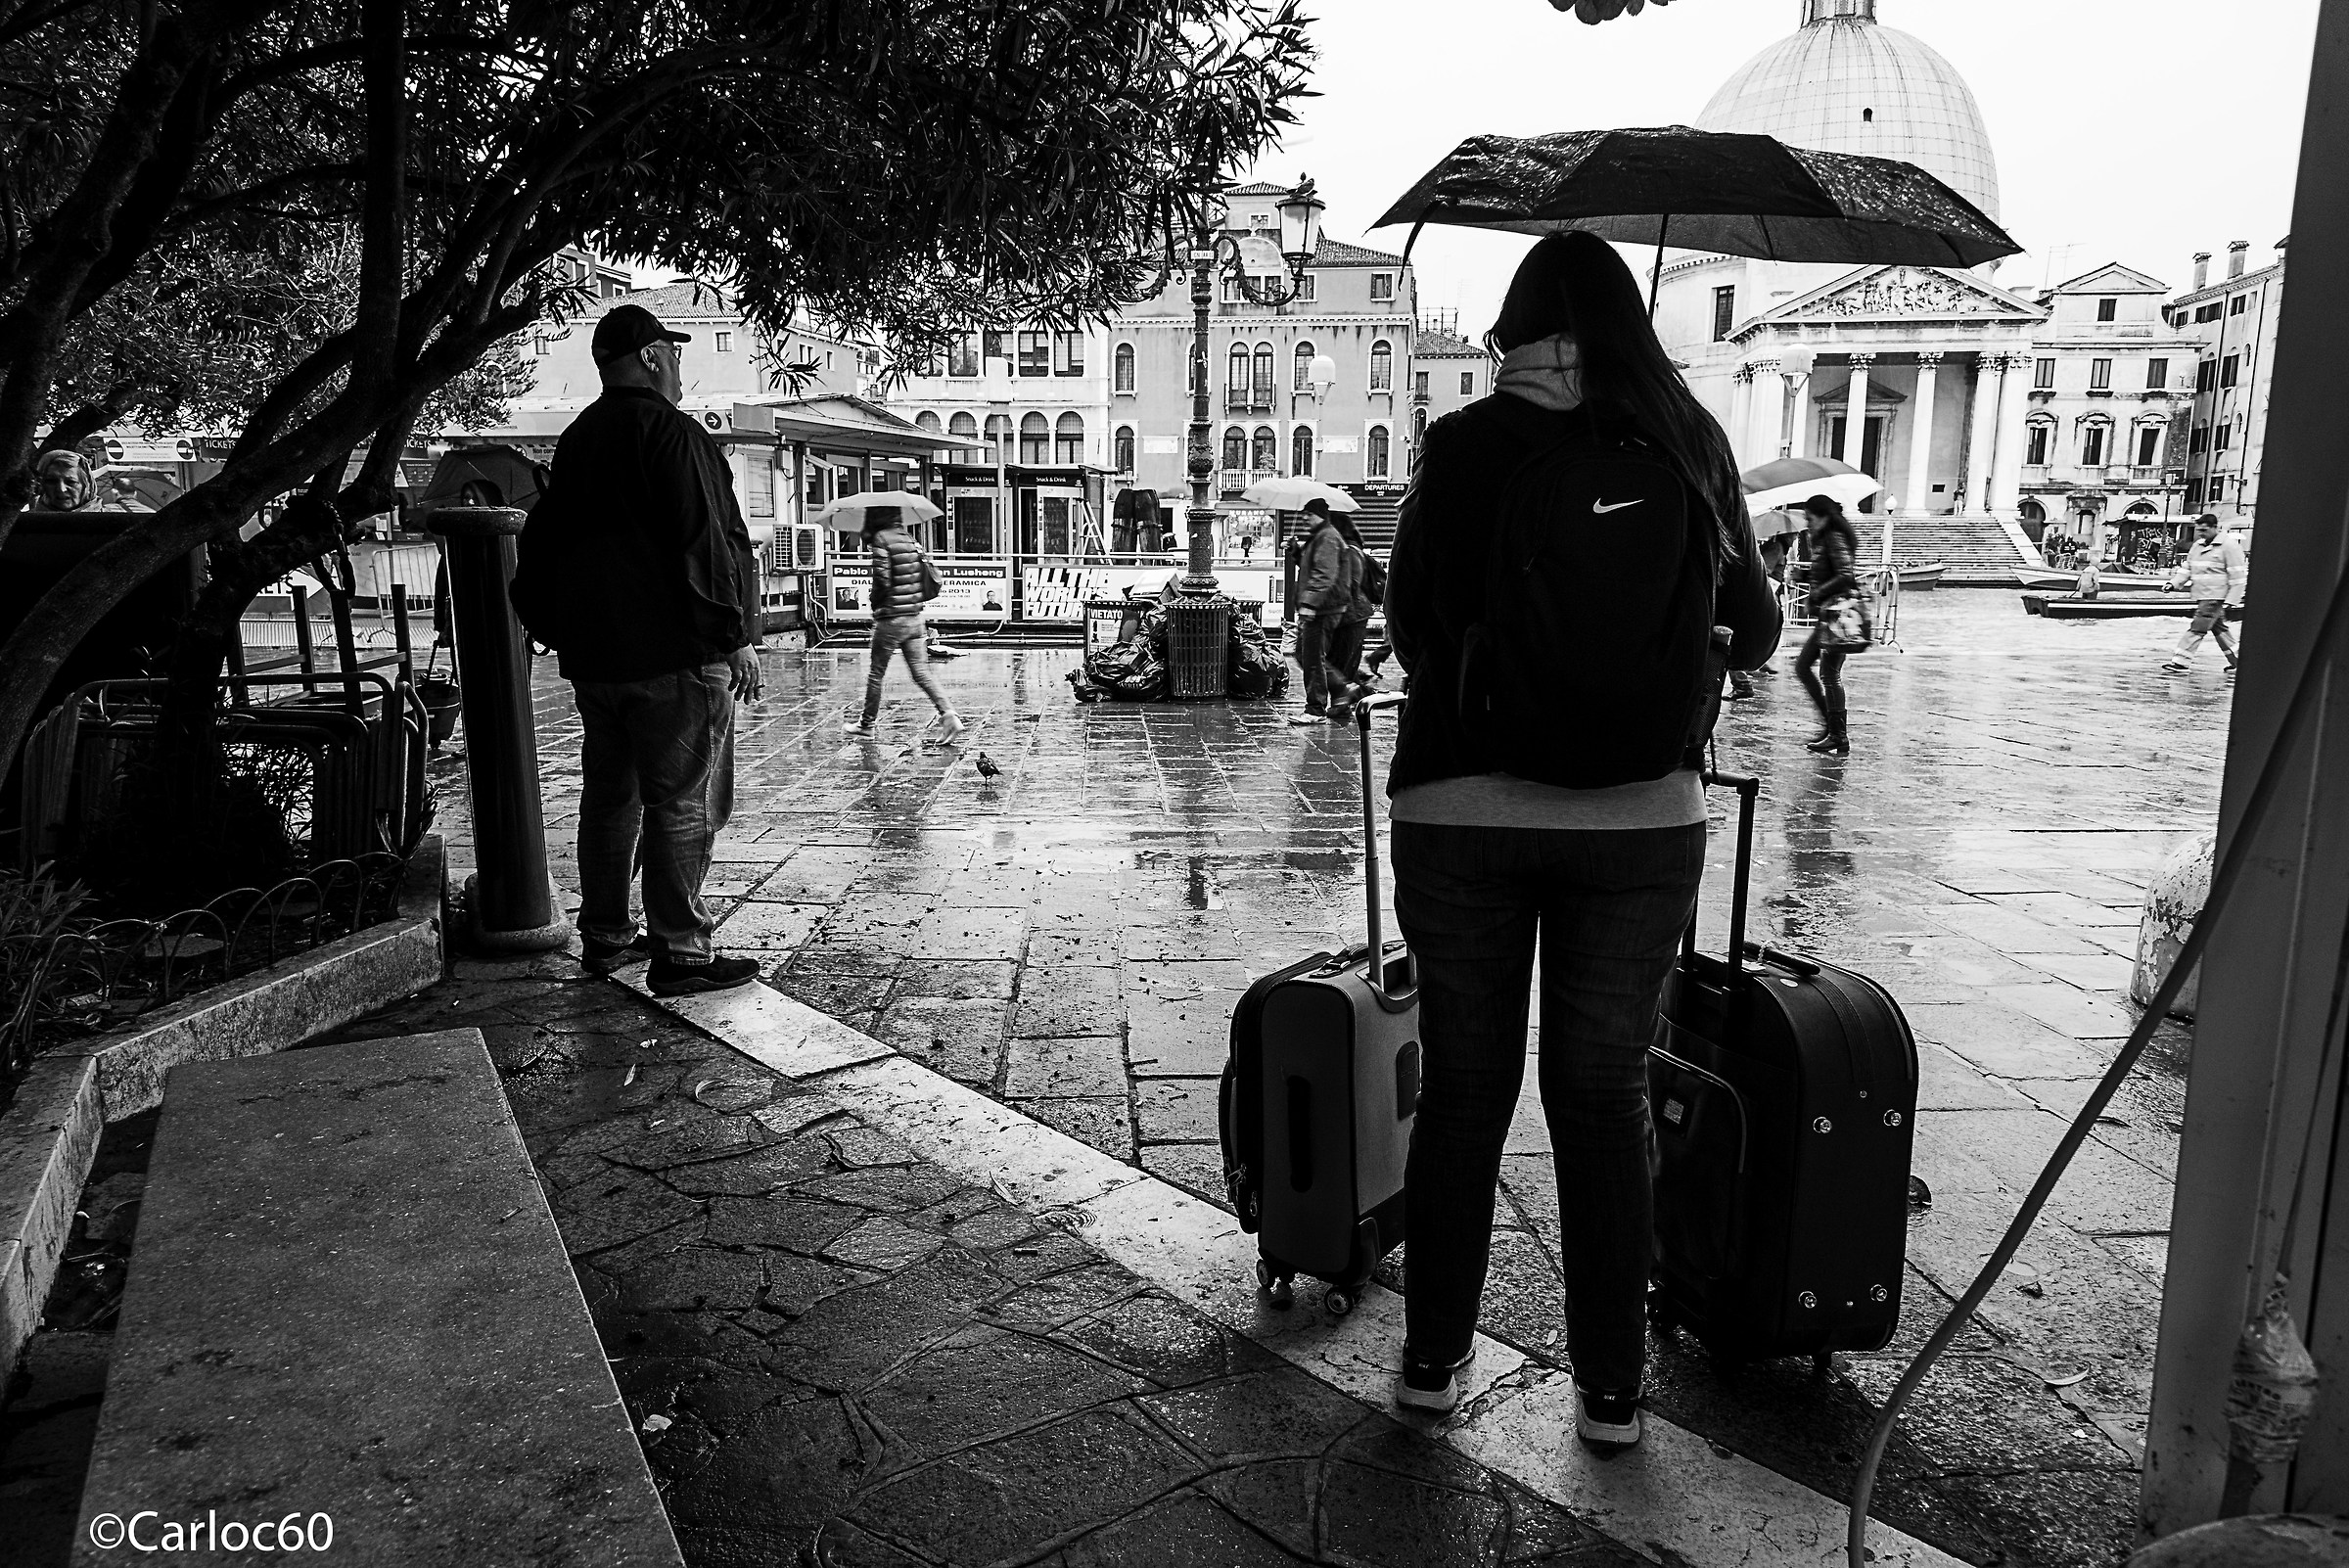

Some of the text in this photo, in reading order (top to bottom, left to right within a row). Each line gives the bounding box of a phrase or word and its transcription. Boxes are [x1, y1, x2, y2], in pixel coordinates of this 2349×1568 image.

[834, 567, 869, 576] Pablo
[953, 569, 1004, 578] Lusheng
[1026, 568, 1065, 587] ALL
[1026, 587, 1109, 602] WORLD'S
[1026, 602, 1083, 618] FUTUR
[1090, 609, 1124, 620] VIETATO
